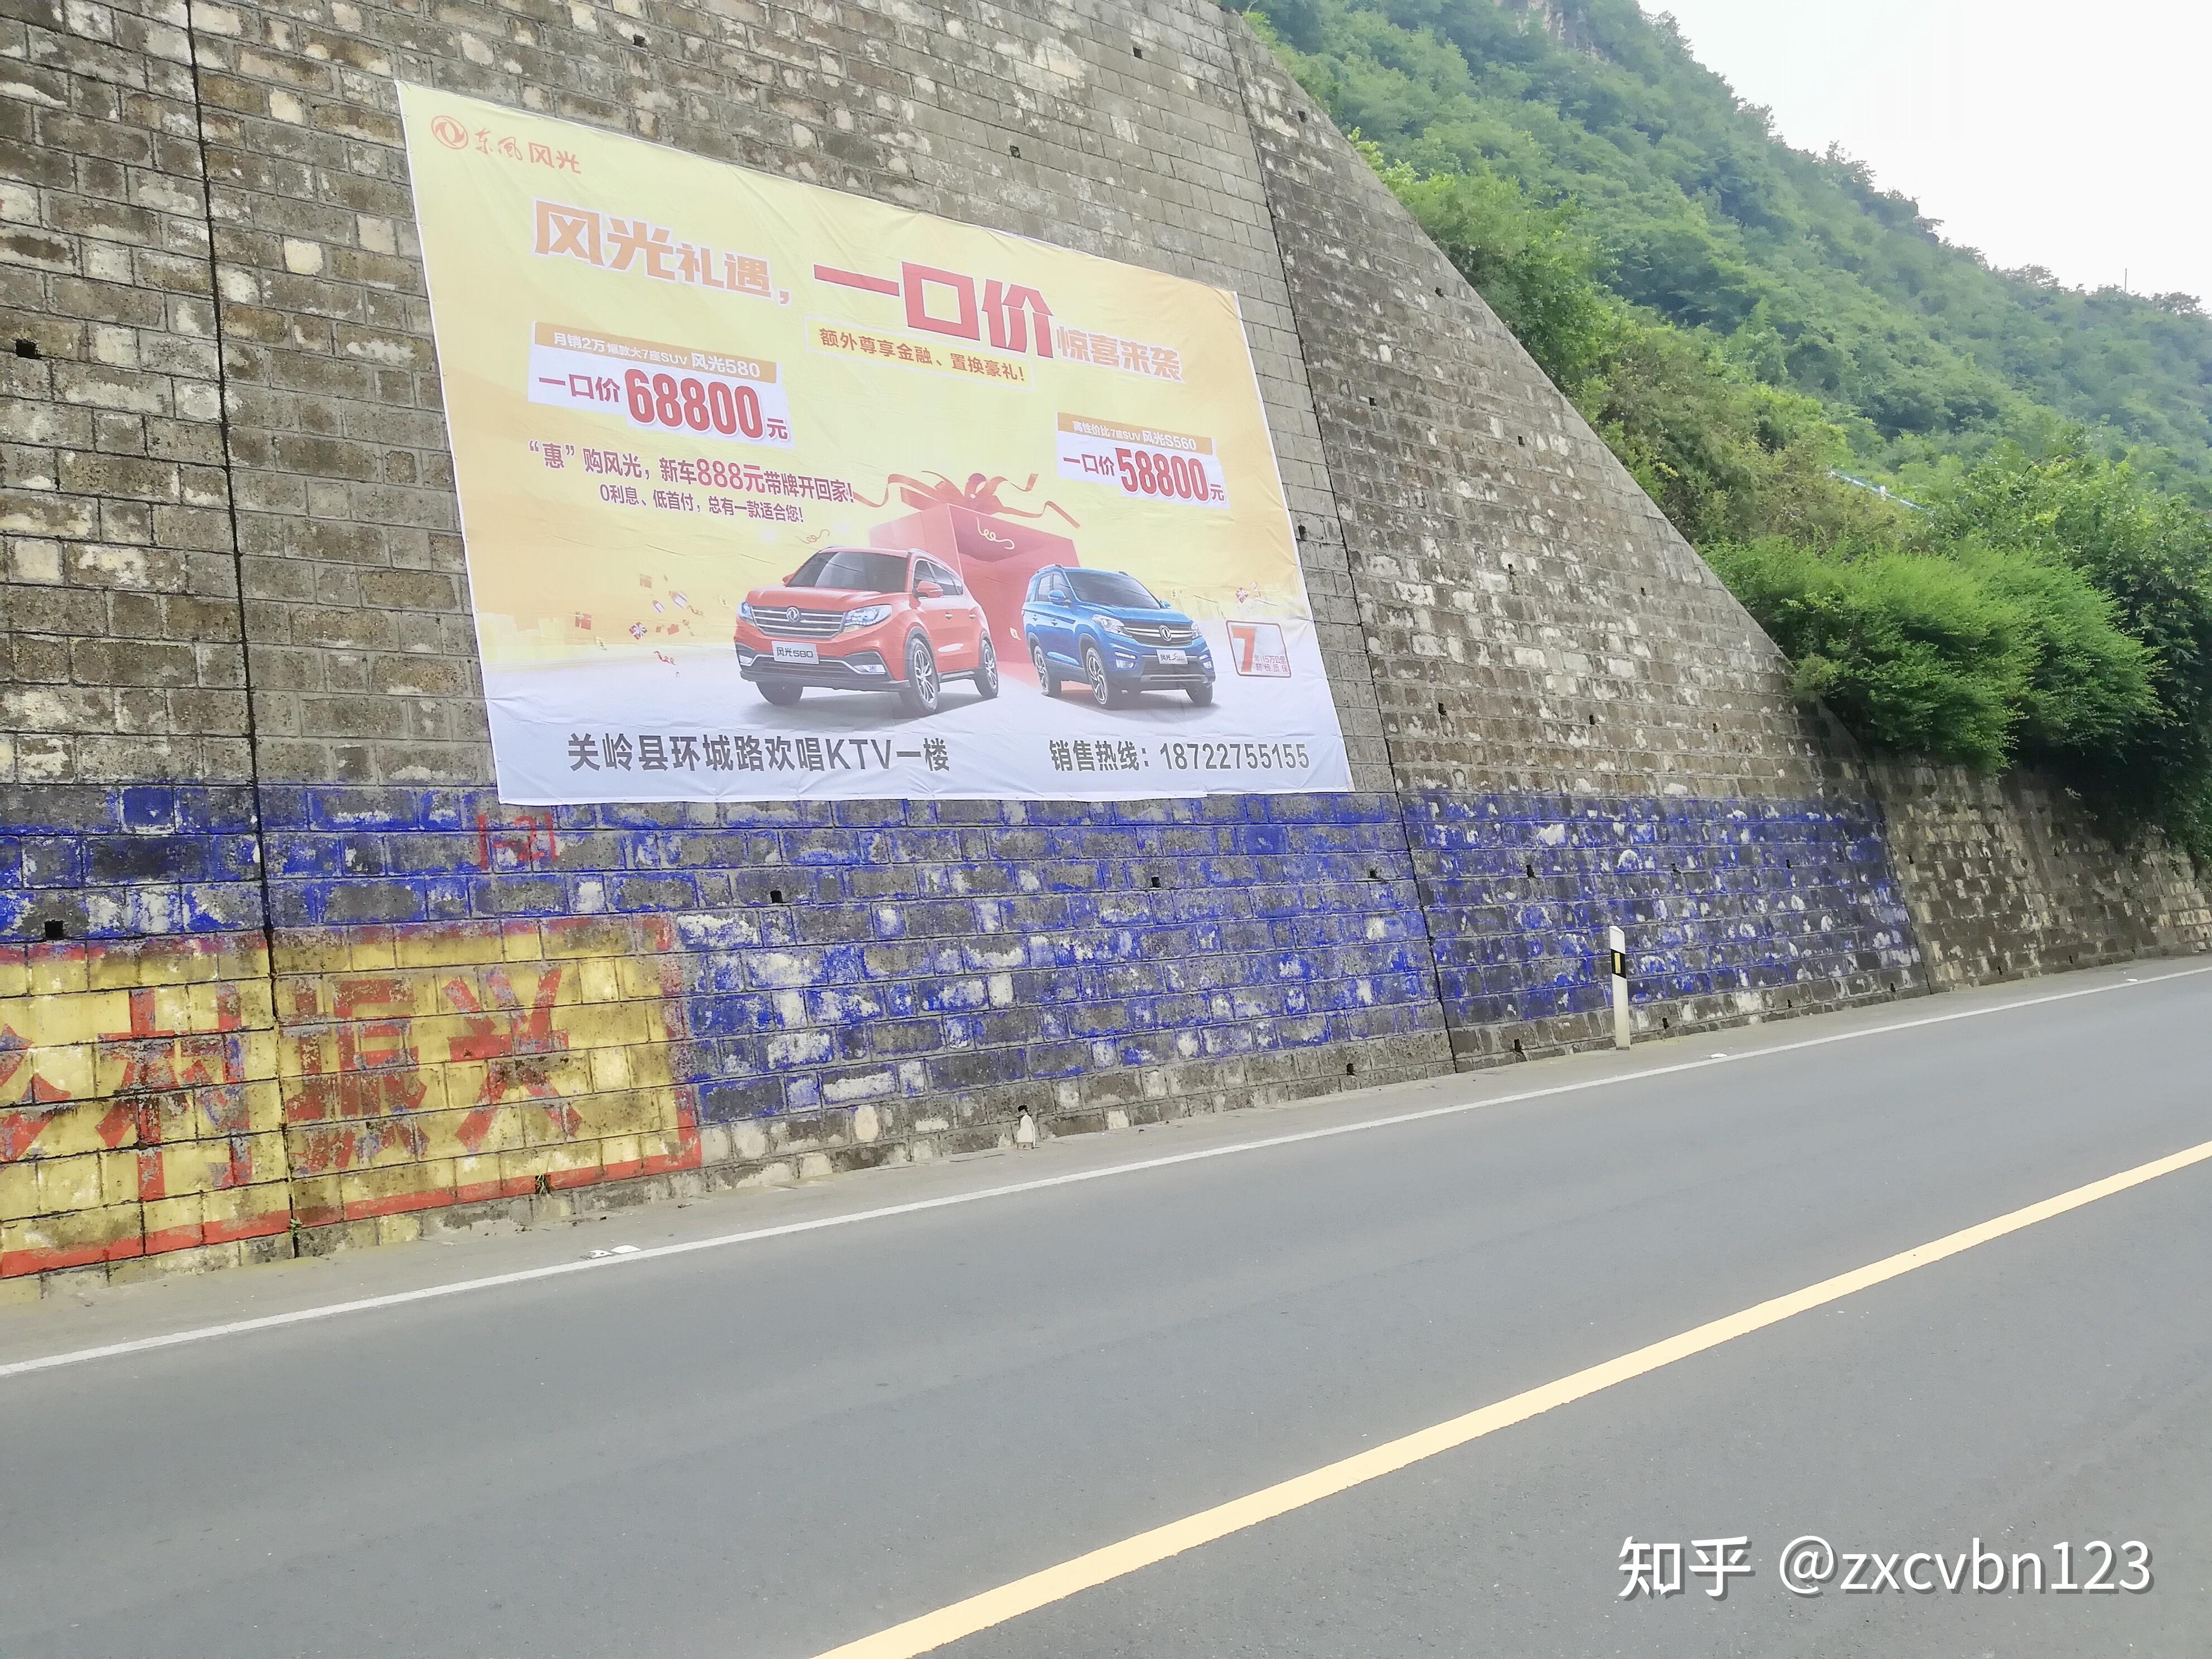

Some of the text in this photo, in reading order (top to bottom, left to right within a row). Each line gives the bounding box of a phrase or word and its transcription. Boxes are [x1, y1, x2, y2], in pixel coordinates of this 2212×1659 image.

[813, 261, 1185, 383] 一口价 惊喜来袭
[777, 647, 814, 658] 风光580
[567, 732, 950, 772] 关岭县环城路欢唱KTV一楼
